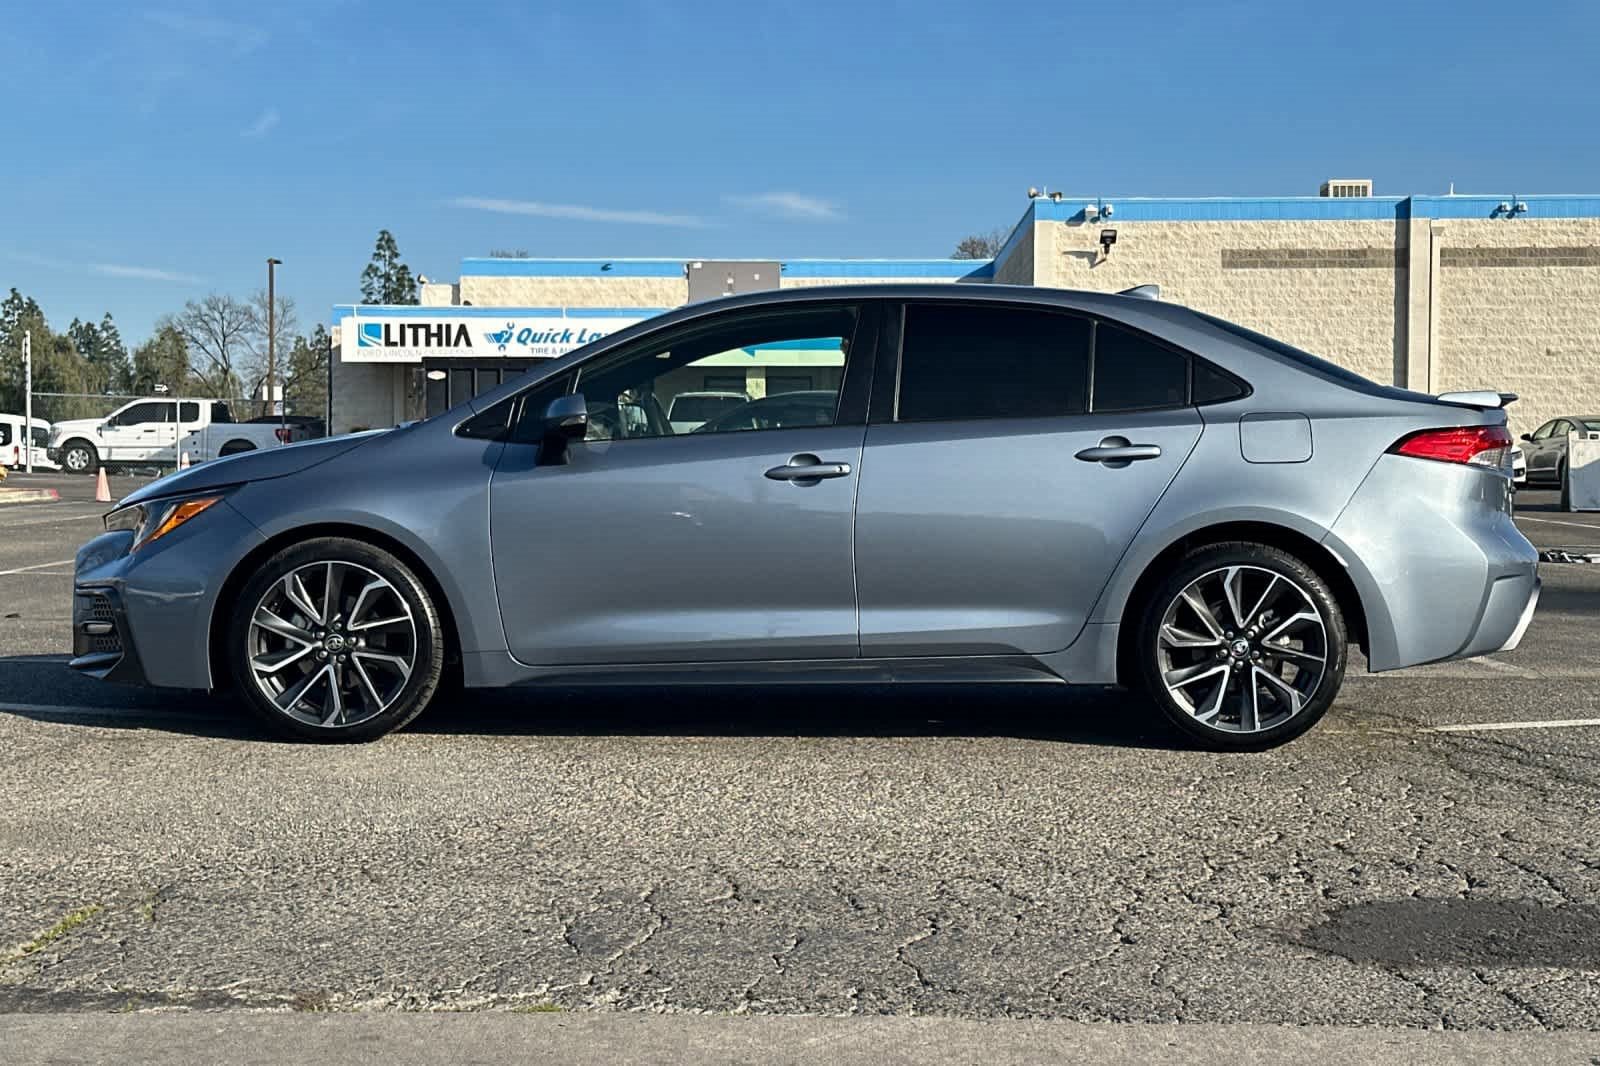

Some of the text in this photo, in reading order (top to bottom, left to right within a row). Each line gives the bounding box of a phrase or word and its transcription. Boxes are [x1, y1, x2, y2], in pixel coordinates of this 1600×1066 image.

[384, 323, 473, 347] LITHIA
[516, 327, 608, 345] Quick La
[530, 347, 547, 356] TIRE
